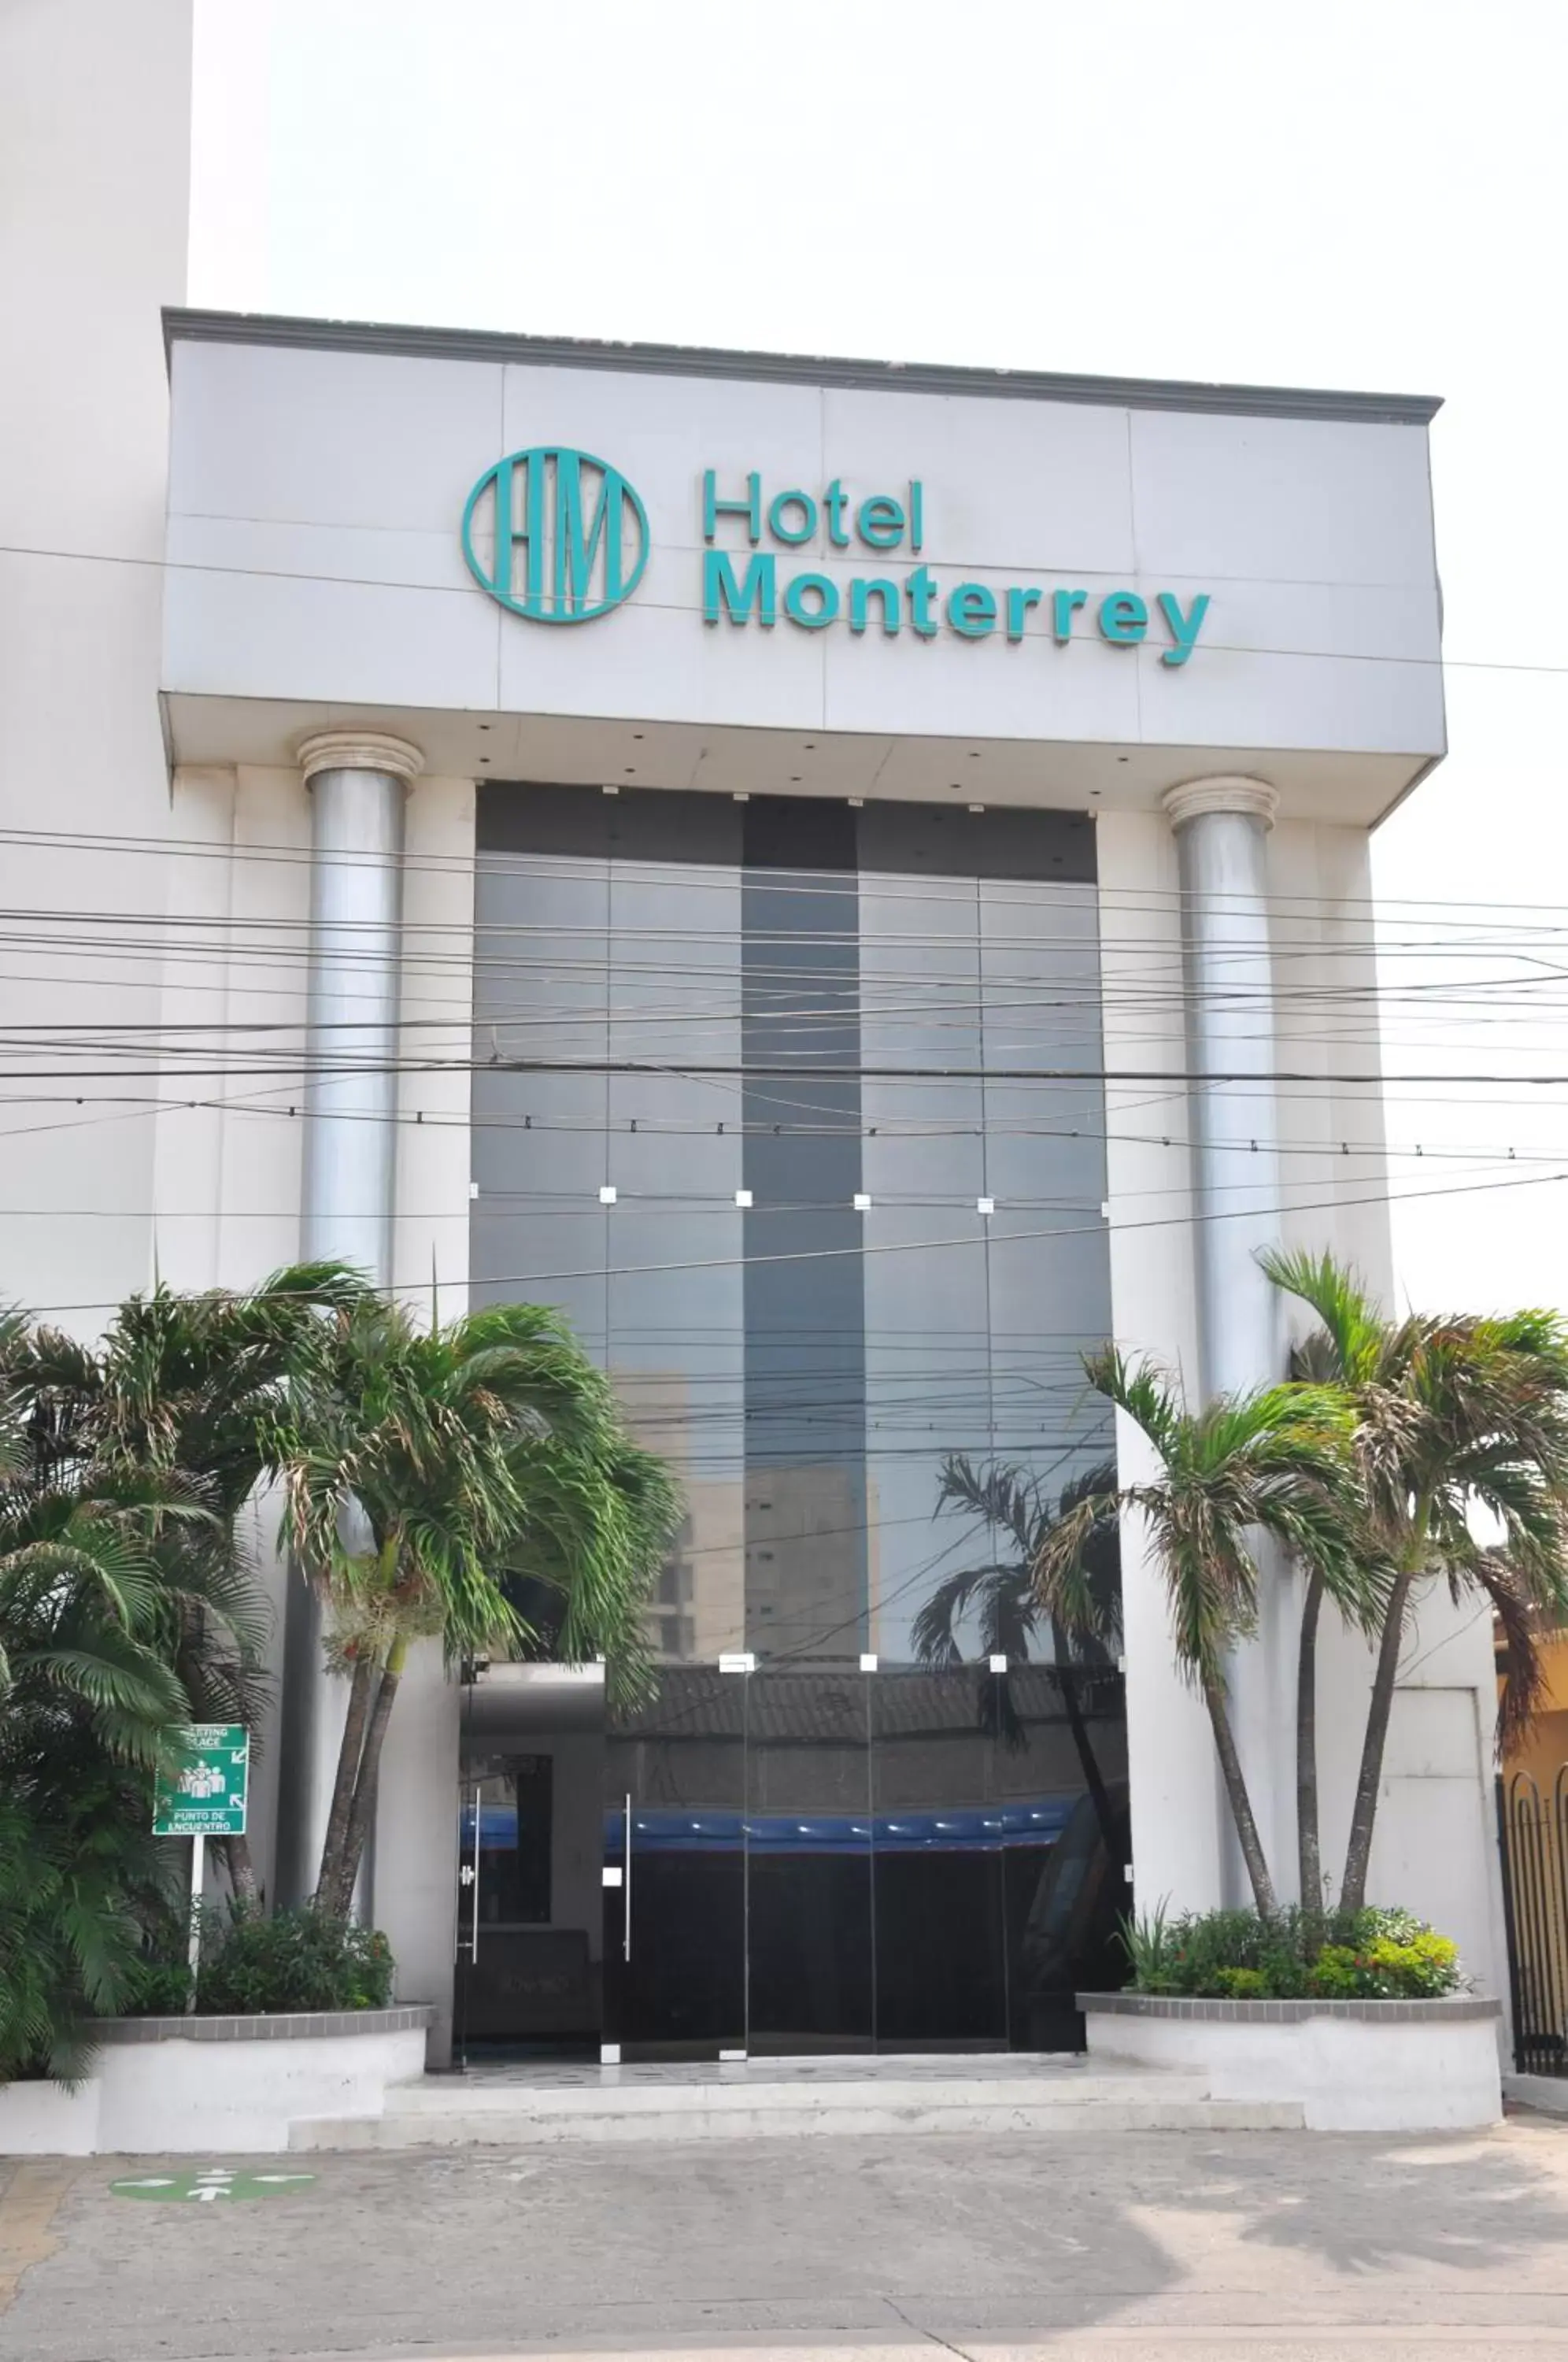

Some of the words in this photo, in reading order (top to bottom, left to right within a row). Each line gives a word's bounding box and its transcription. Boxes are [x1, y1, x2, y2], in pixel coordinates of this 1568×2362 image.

[704, 470, 923, 549] Hotel
[491, 447, 623, 621] HM
[704, 550, 1210, 665] Monterrey
[184, 1727, 227, 1738] EETING
[168, 1822, 231, 1831] ENCUENTRO
[174, 1812, 209, 1820] PUNTO
[212, 1812, 226, 1820] DE
